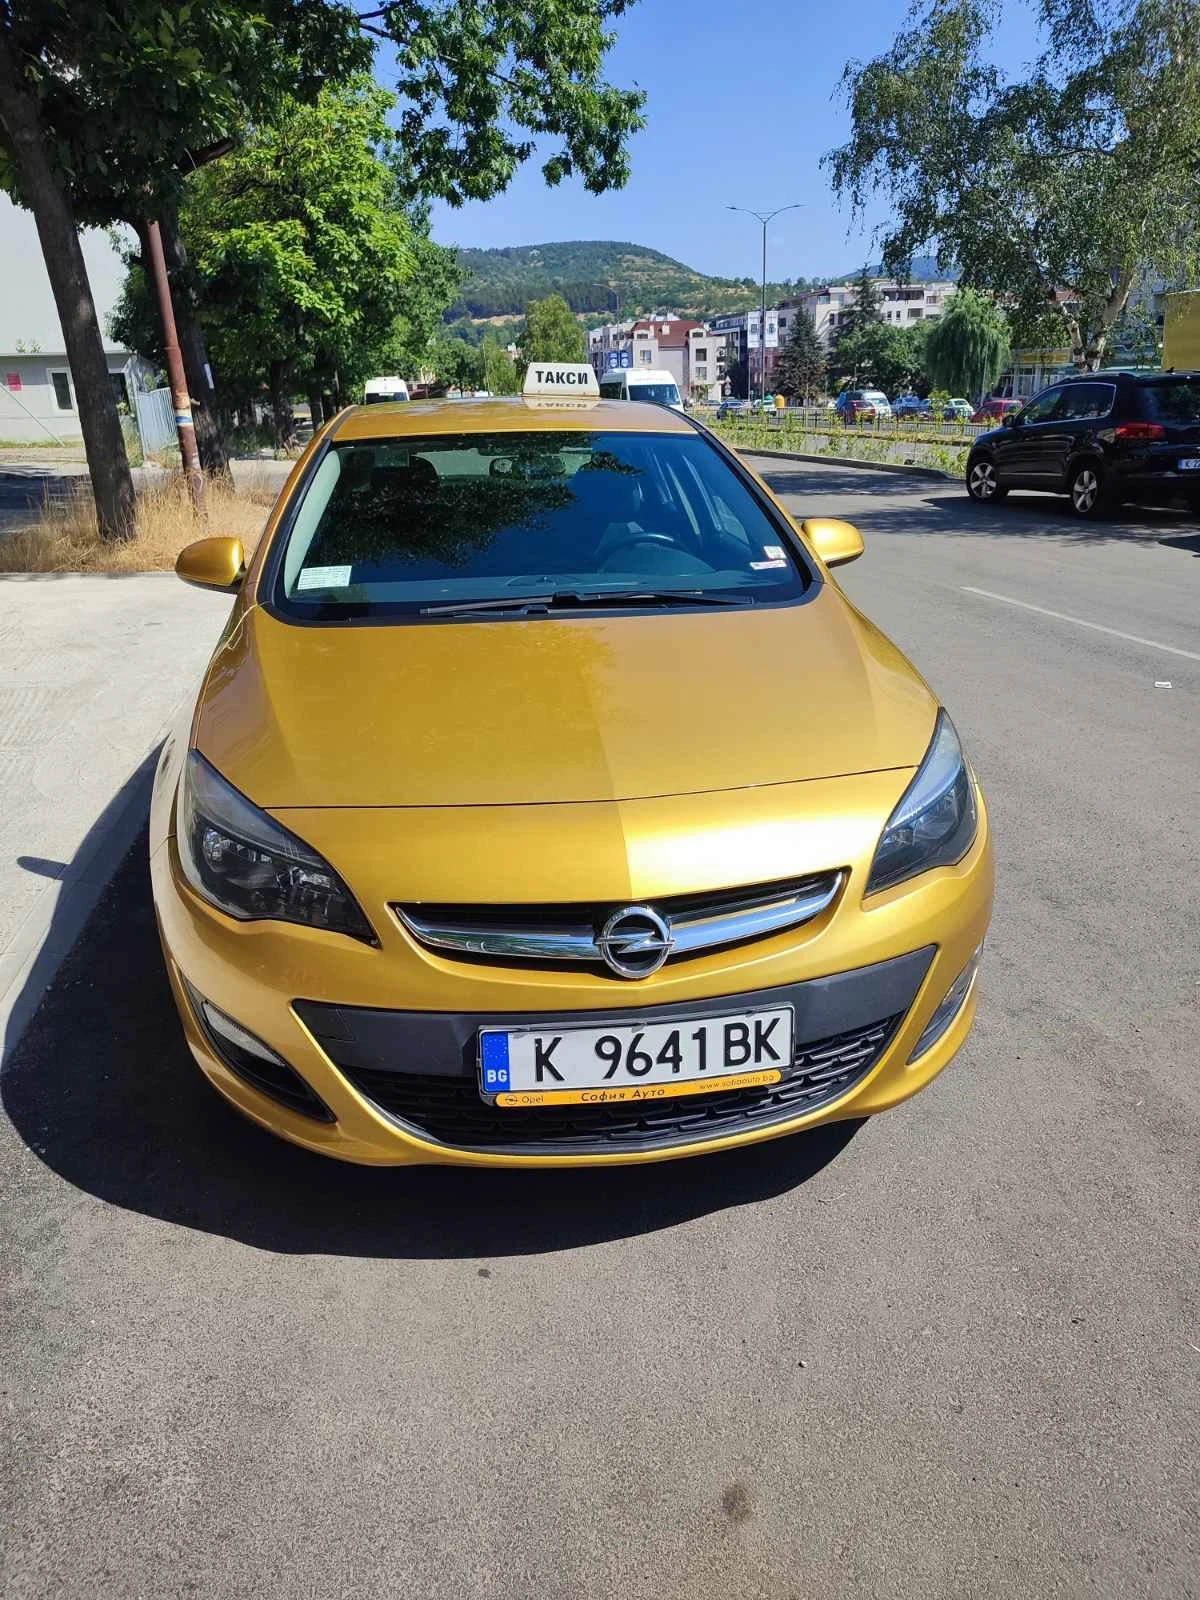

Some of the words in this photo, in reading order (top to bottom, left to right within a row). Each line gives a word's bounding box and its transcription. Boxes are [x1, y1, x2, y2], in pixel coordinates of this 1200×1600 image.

[535, 370, 588, 385] ТАКСИ
[534, 1036, 566, 1082] K
[594, 1025, 708, 1080] 9641
[723, 1017, 781, 1067] BK
[487, 1069, 508, 1083] BG
[521, 1095, 544, 1104] Opel
[581, 1090, 625, 1102] София
[632, 1089, 665, 1099] Ауто
